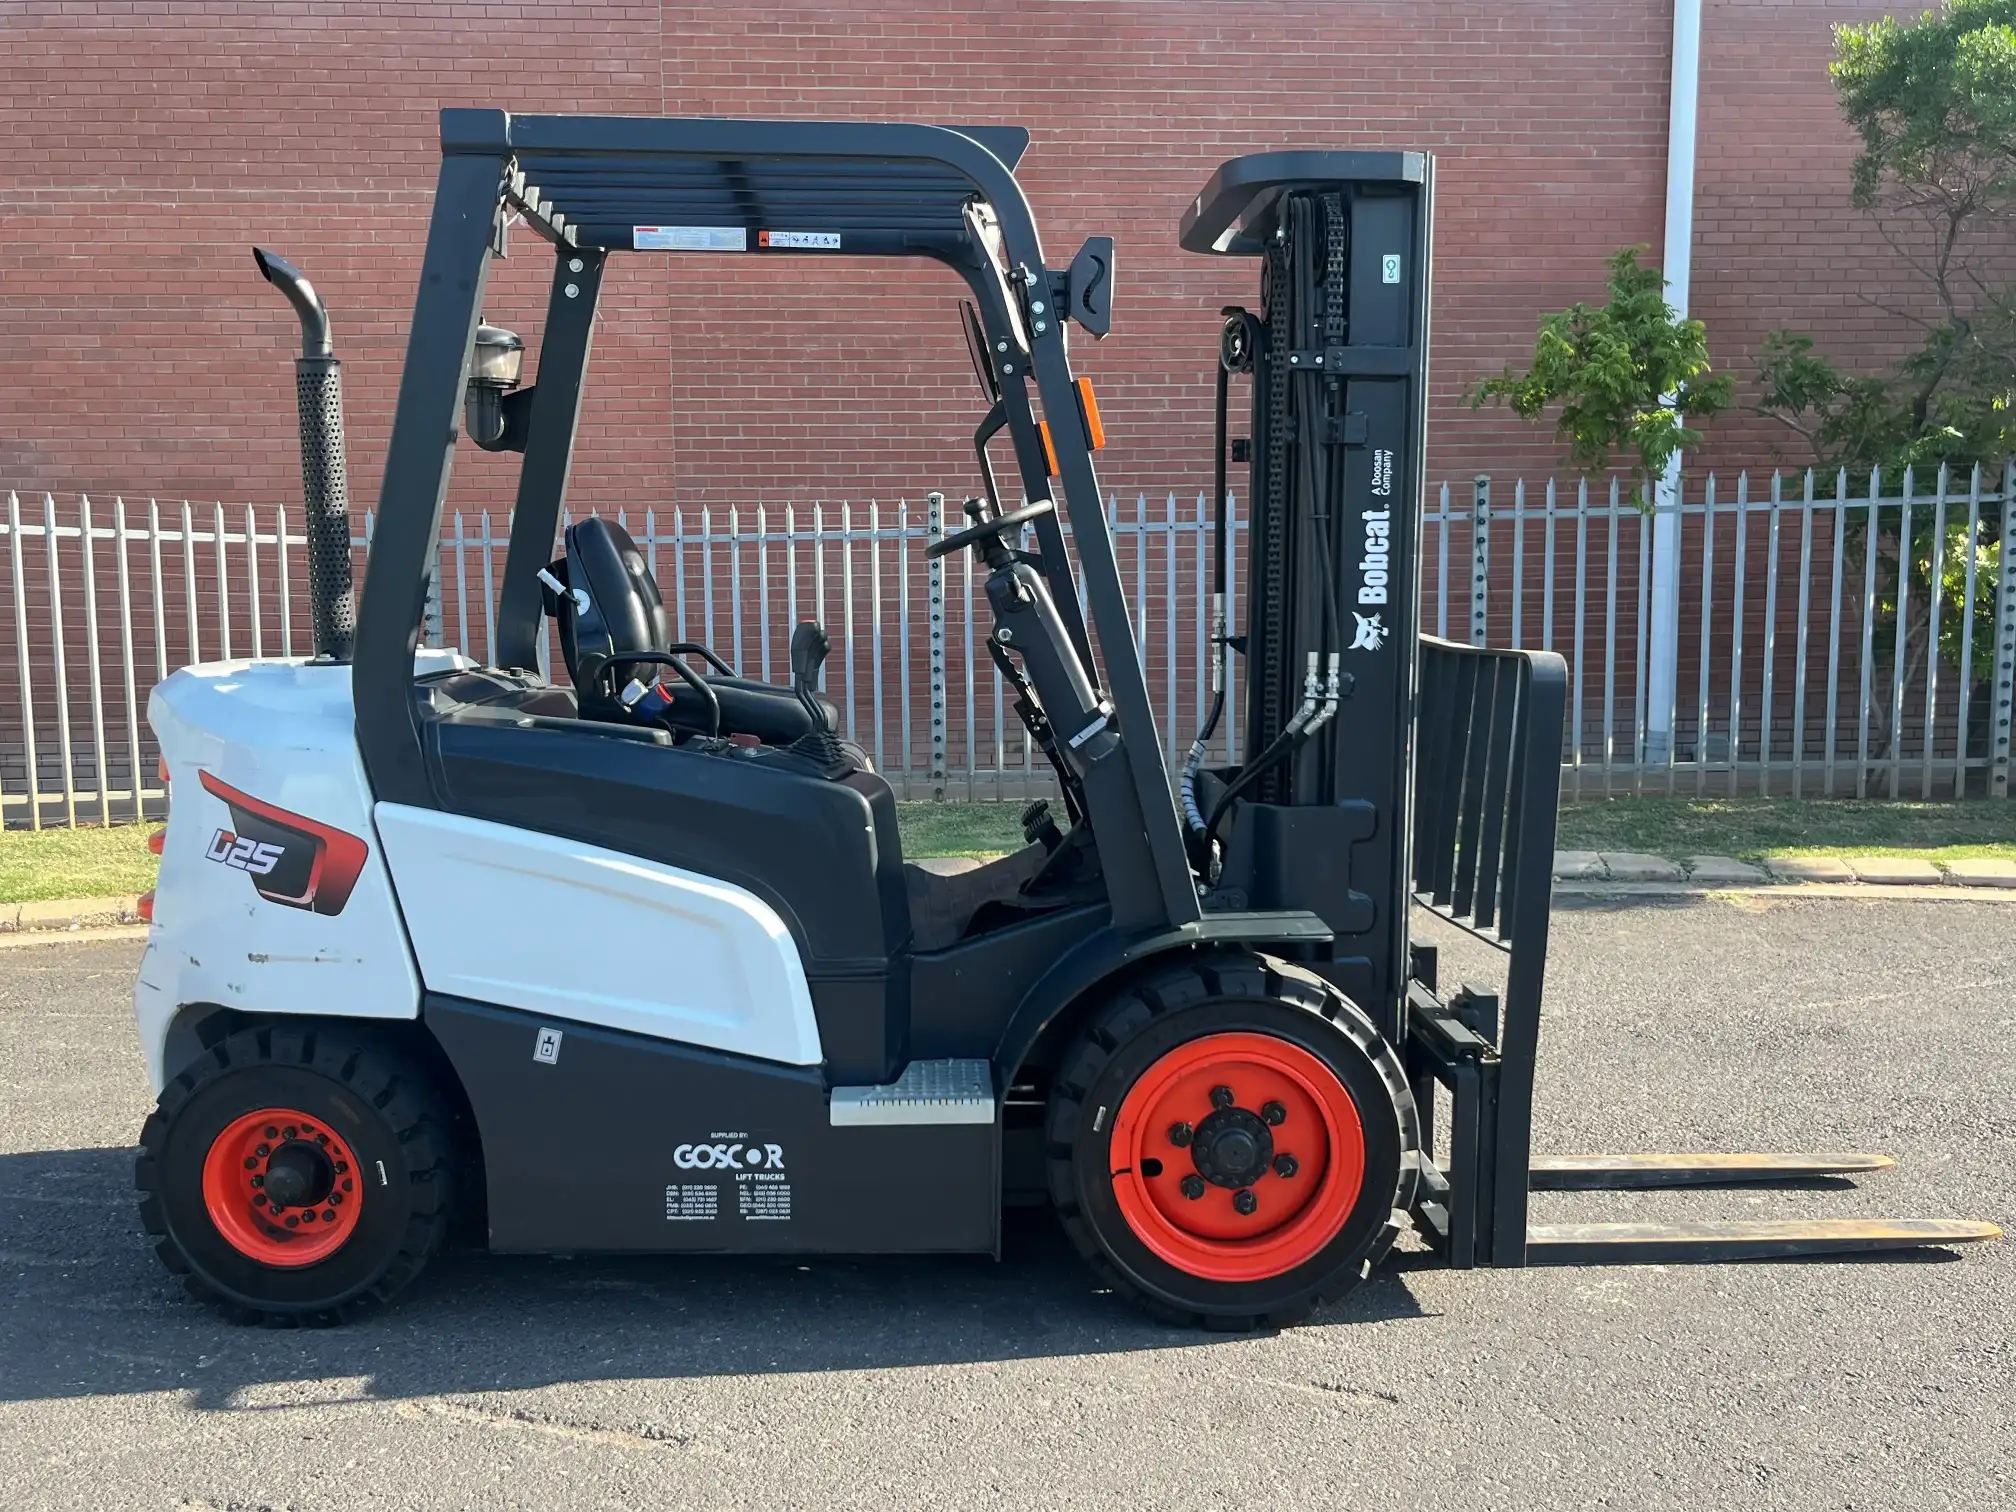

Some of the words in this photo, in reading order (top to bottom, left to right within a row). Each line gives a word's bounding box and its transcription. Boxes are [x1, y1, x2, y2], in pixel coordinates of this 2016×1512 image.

[1371, 449, 1382, 485] Doosan
[1380, 449, 1394, 496] Company
[1371, 487, 1381, 496] A
[1358, 510, 1390, 604] Bobcat
[710, 1131, 738, 1139] SUPPLIED
[735, 1173, 753, 1181] LIFT
[754, 1173, 786, 1181] TRUCKS
